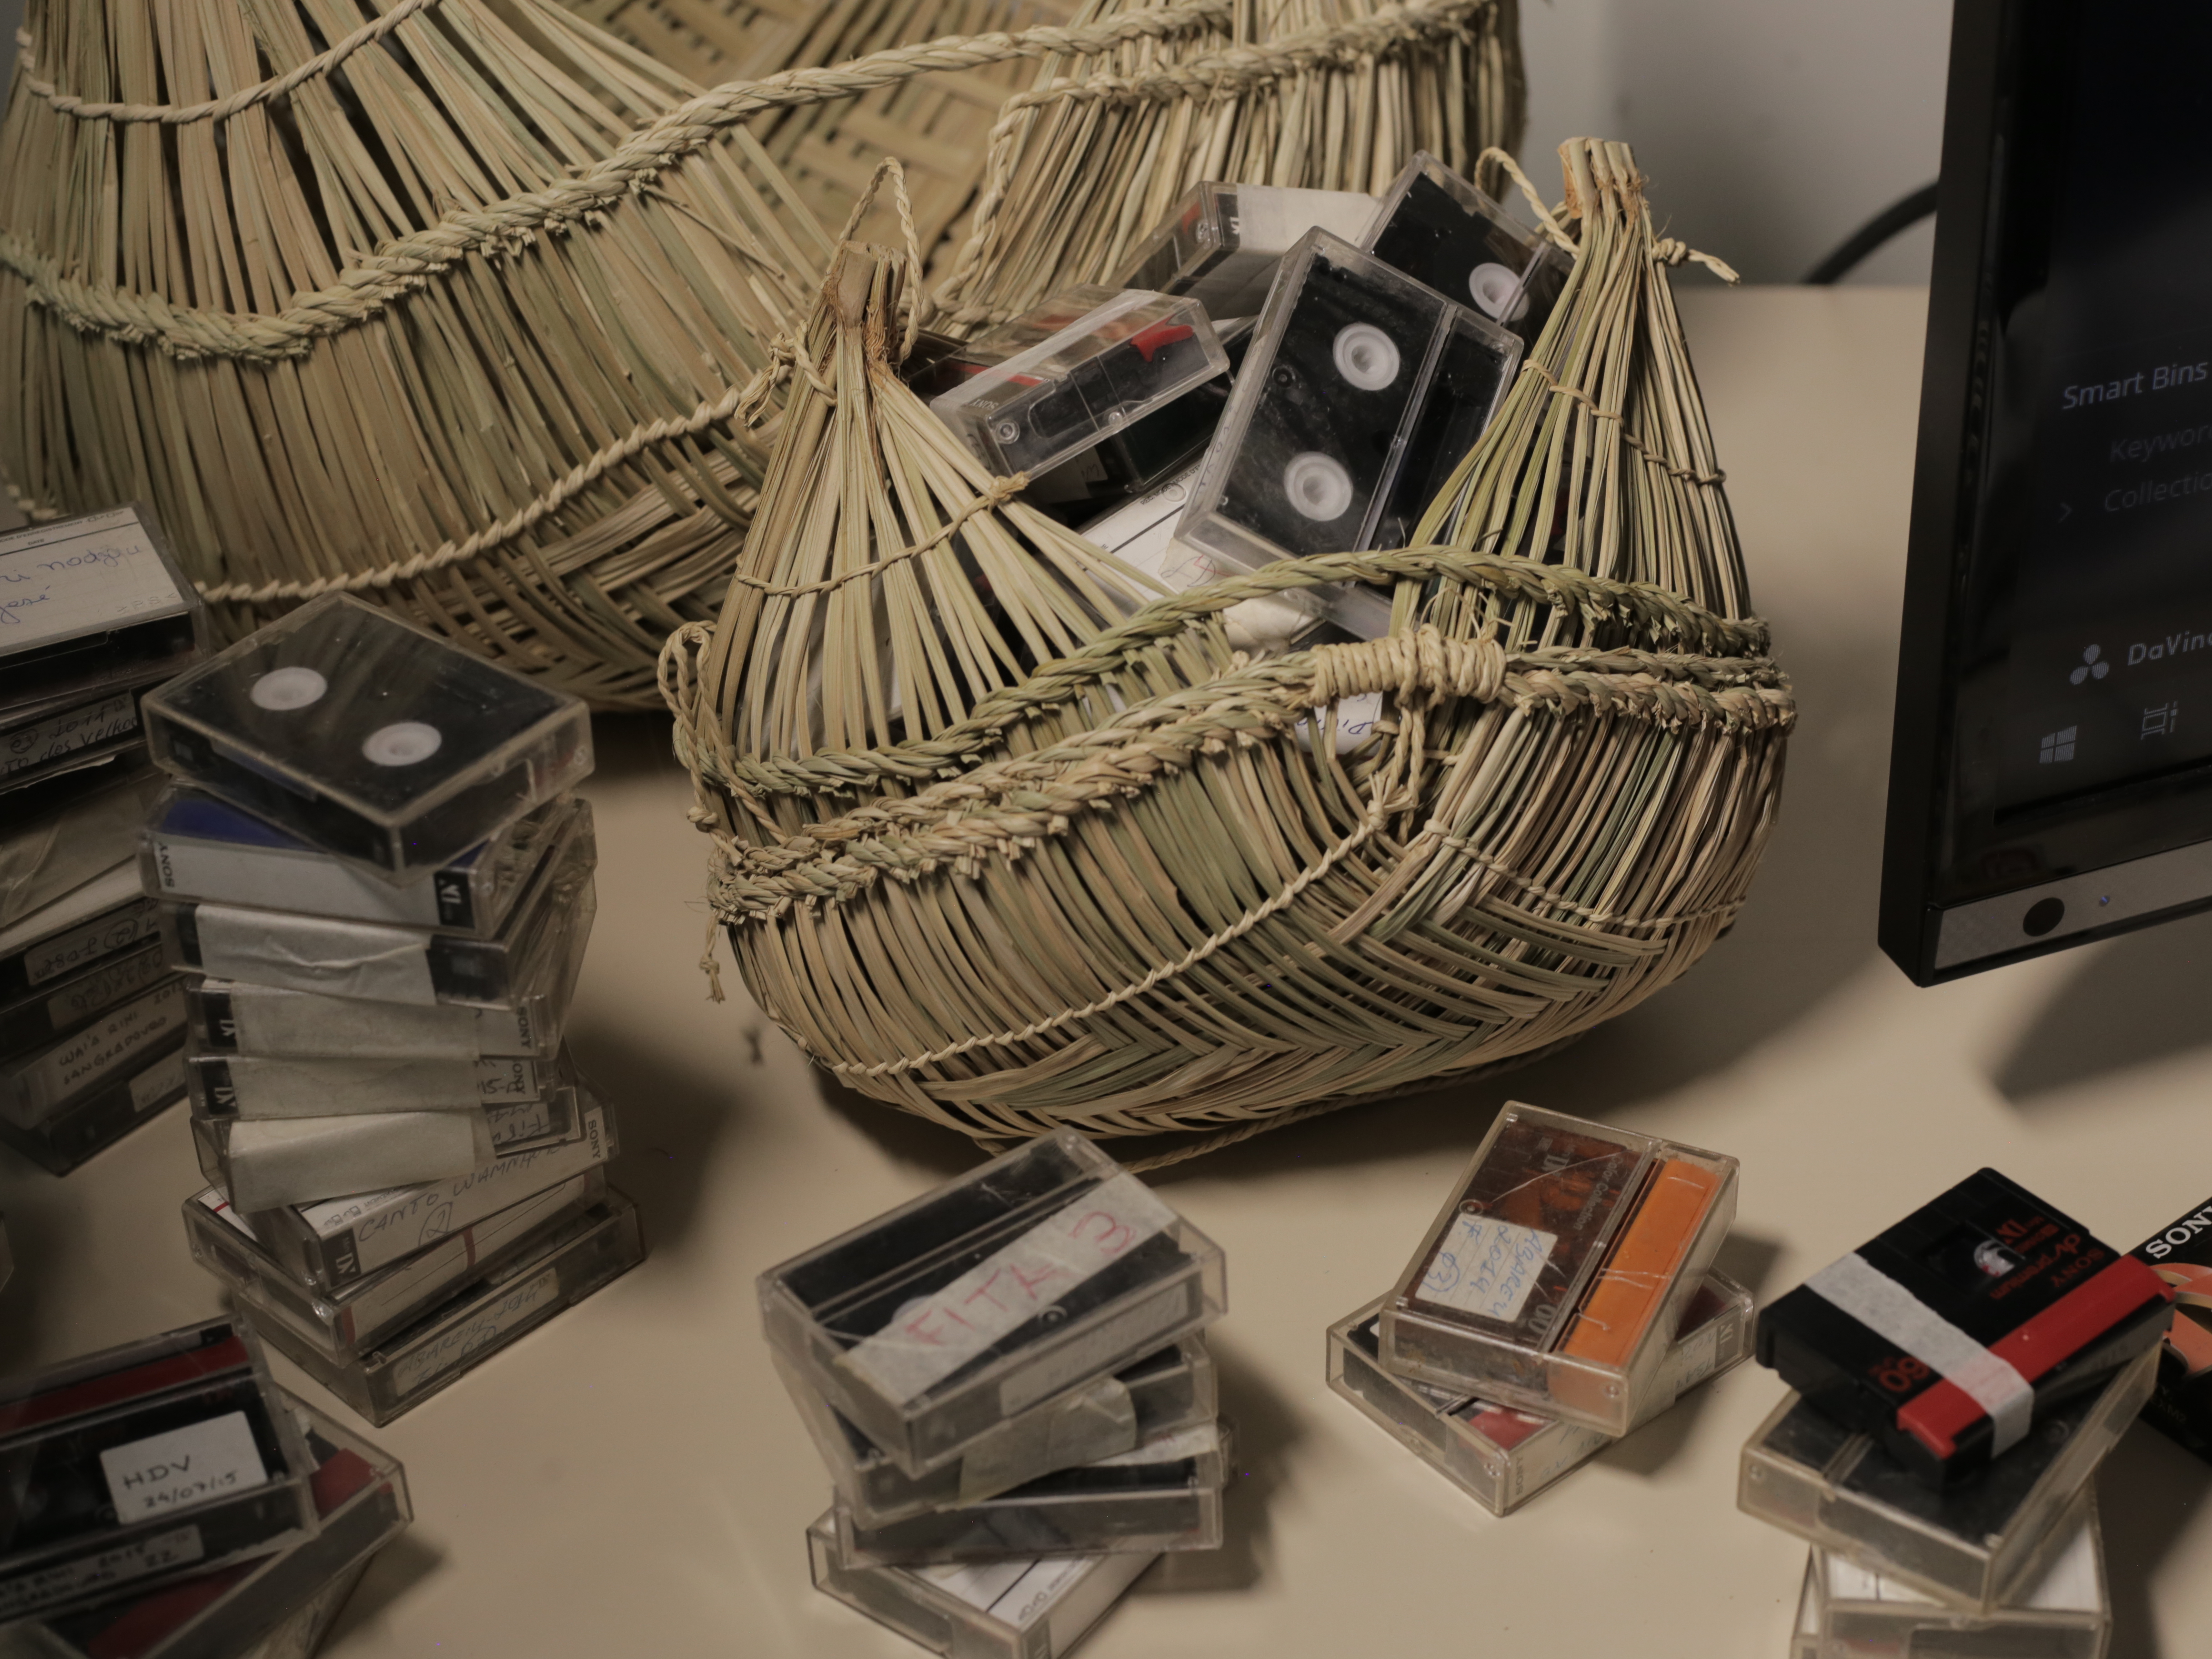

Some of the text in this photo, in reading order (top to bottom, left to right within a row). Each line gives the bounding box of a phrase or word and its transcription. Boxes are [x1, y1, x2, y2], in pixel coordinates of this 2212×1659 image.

[2063, 362, 2209, 409] Smart Bins
[158, 841, 175, 888] SONY
[516, 1006, 531, 1049] SONY
[587, 1118, 603, 1160] SONY
[121, 1453, 191, 1490] HDV
